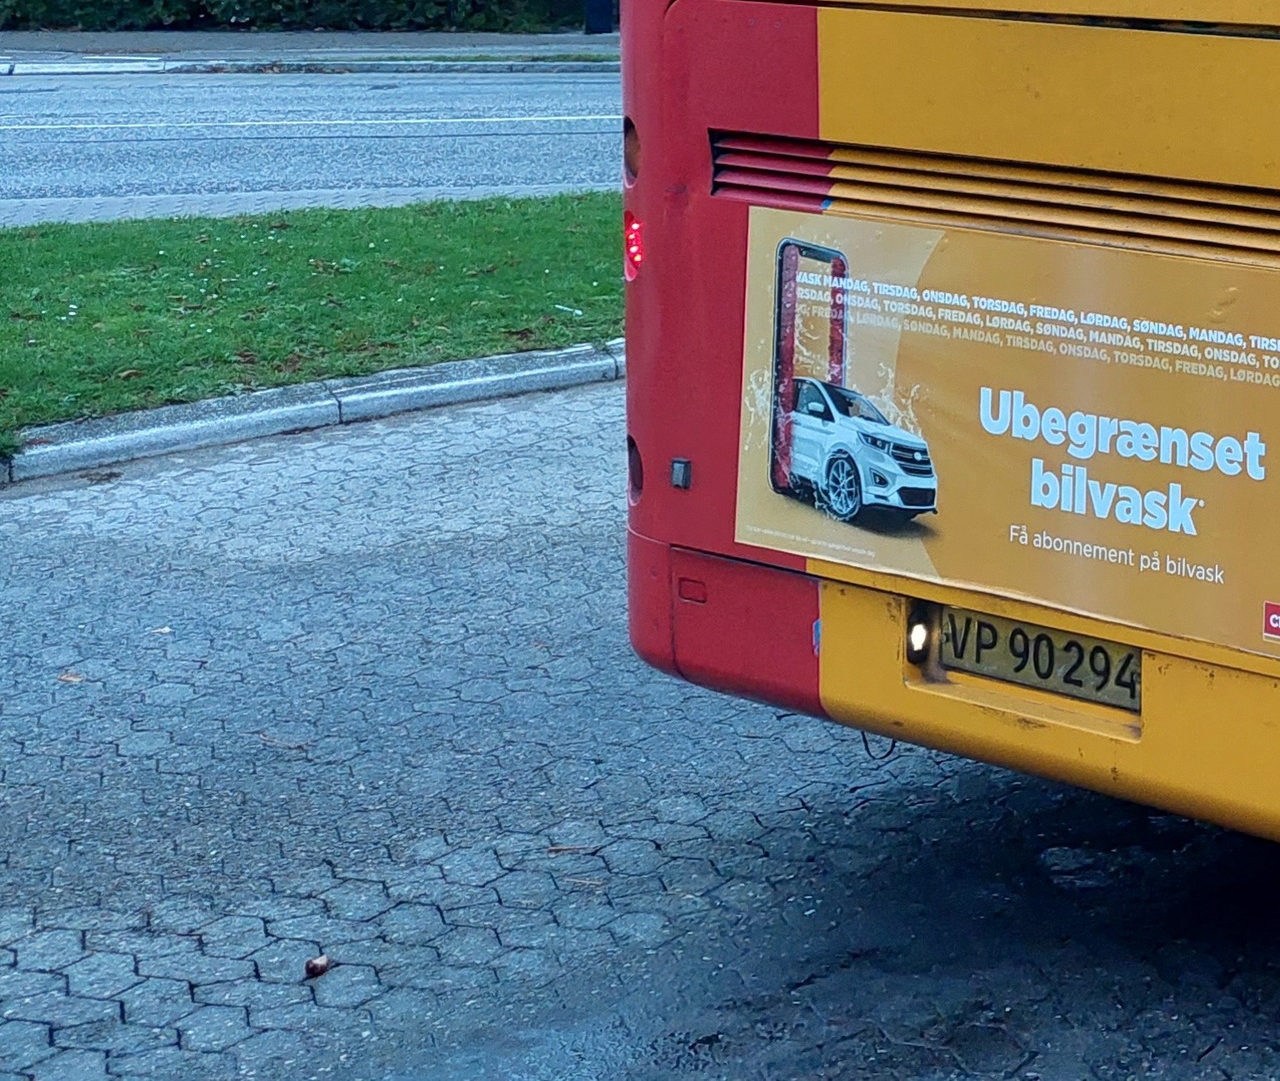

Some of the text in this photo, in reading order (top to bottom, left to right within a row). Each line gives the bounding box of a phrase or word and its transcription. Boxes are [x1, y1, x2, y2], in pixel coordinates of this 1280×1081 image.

[823, 276, 871, 295] MANDAG,
[872, 282, 921, 302] TIRSDAG,
[922, 290, 970, 309] ONSDAG,
[972, 296, 1028, 317] TORSDAG,
[1030, 305, 1078, 325] FREDAG,
[1080, 312, 1131, 332] LØRDAG,
[1133, 319, 1186, 341] SØNDAG,
[1189, 327, 1246, 349] MANDAG,
[836, 295, 880, 311] ONSDAG,
[883, 300, 936, 321] TORSDAG,
[938, 309, 984, 327] FREDAG,
[986, 314, 1034, 335] LØRDAG,
[1036, 322, 1087, 343] SØNDAG,
[1089, 330, 1144, 351] MANDAG,
[1146, 338, 1202, 361] TIRSDAG,
[1204, 347, 1260, 369] ONSDAG,
[903, 319, 950, 339] SØNDAG,
[952, 327, 1003, 347] MANDAG,
[1005, 335, 1056, 355] TIRSDAG,
[1059, 343, 1111, 363] ONSDAG,
[1113, 351, 1172, 373] TORSDAG,
[1175, 360, 1228, 381] FREDAG,
[979, 386, 1267, 481] Ubegrænset
[1010, 525, 1225, 585] Få abonnement på bilvask
[948, 613, 1138, 700] VP 90294
